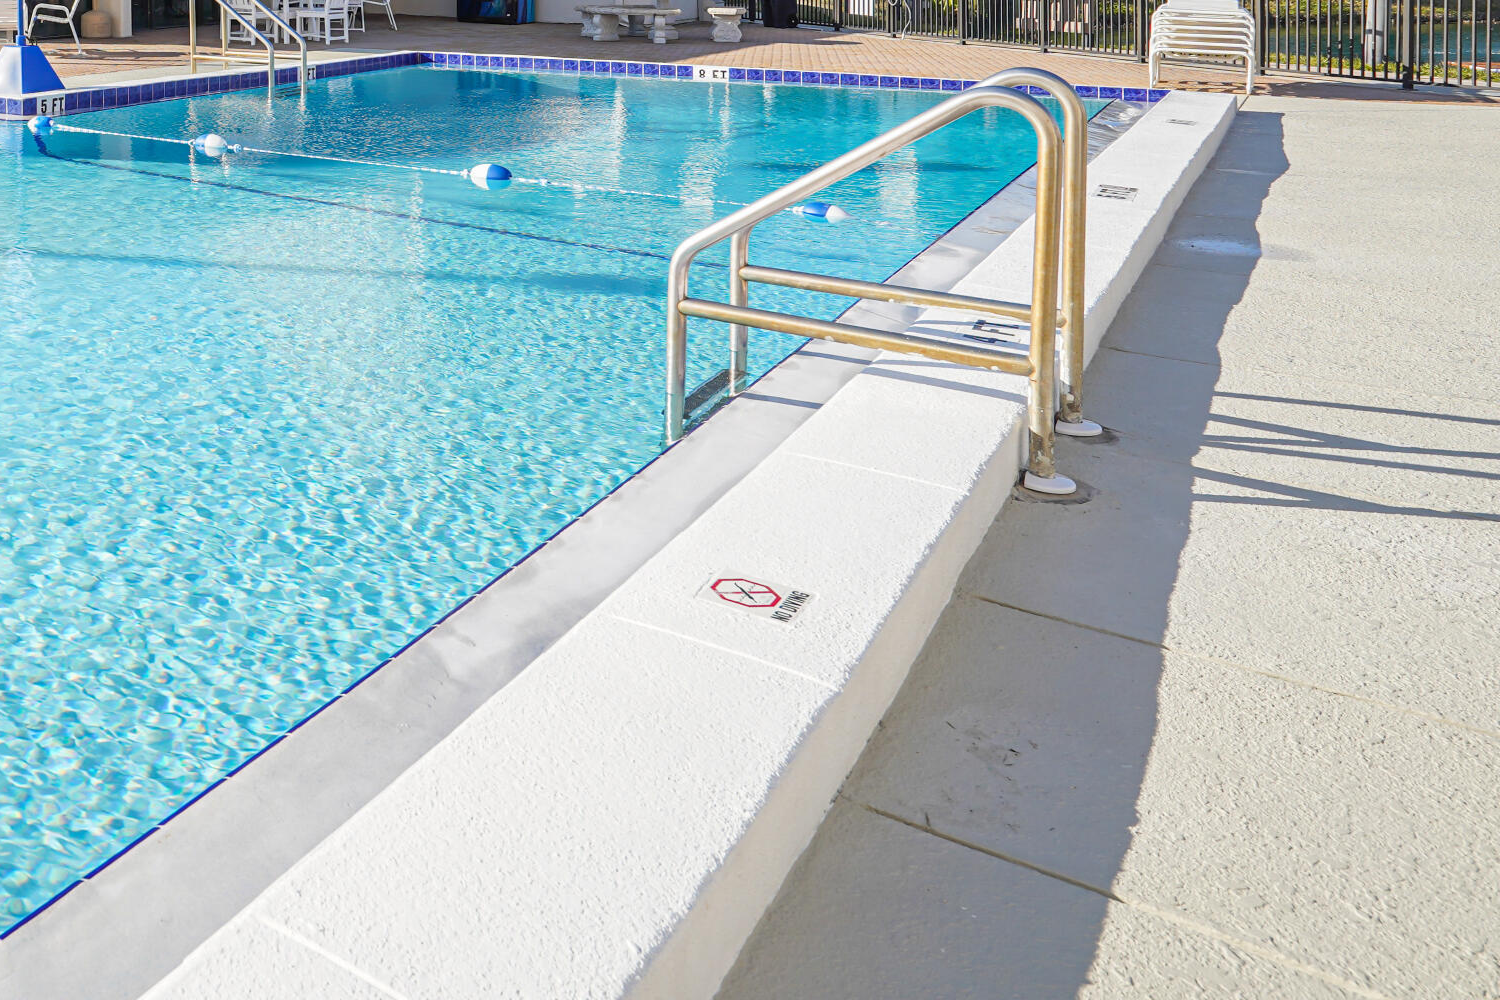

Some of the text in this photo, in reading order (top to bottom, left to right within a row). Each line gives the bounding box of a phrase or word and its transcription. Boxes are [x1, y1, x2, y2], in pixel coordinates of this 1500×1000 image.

[699, 69, 706, 78] 8
[41, 99, 48, 113] 5
[770, 590, 810, 622] NO DIVING
